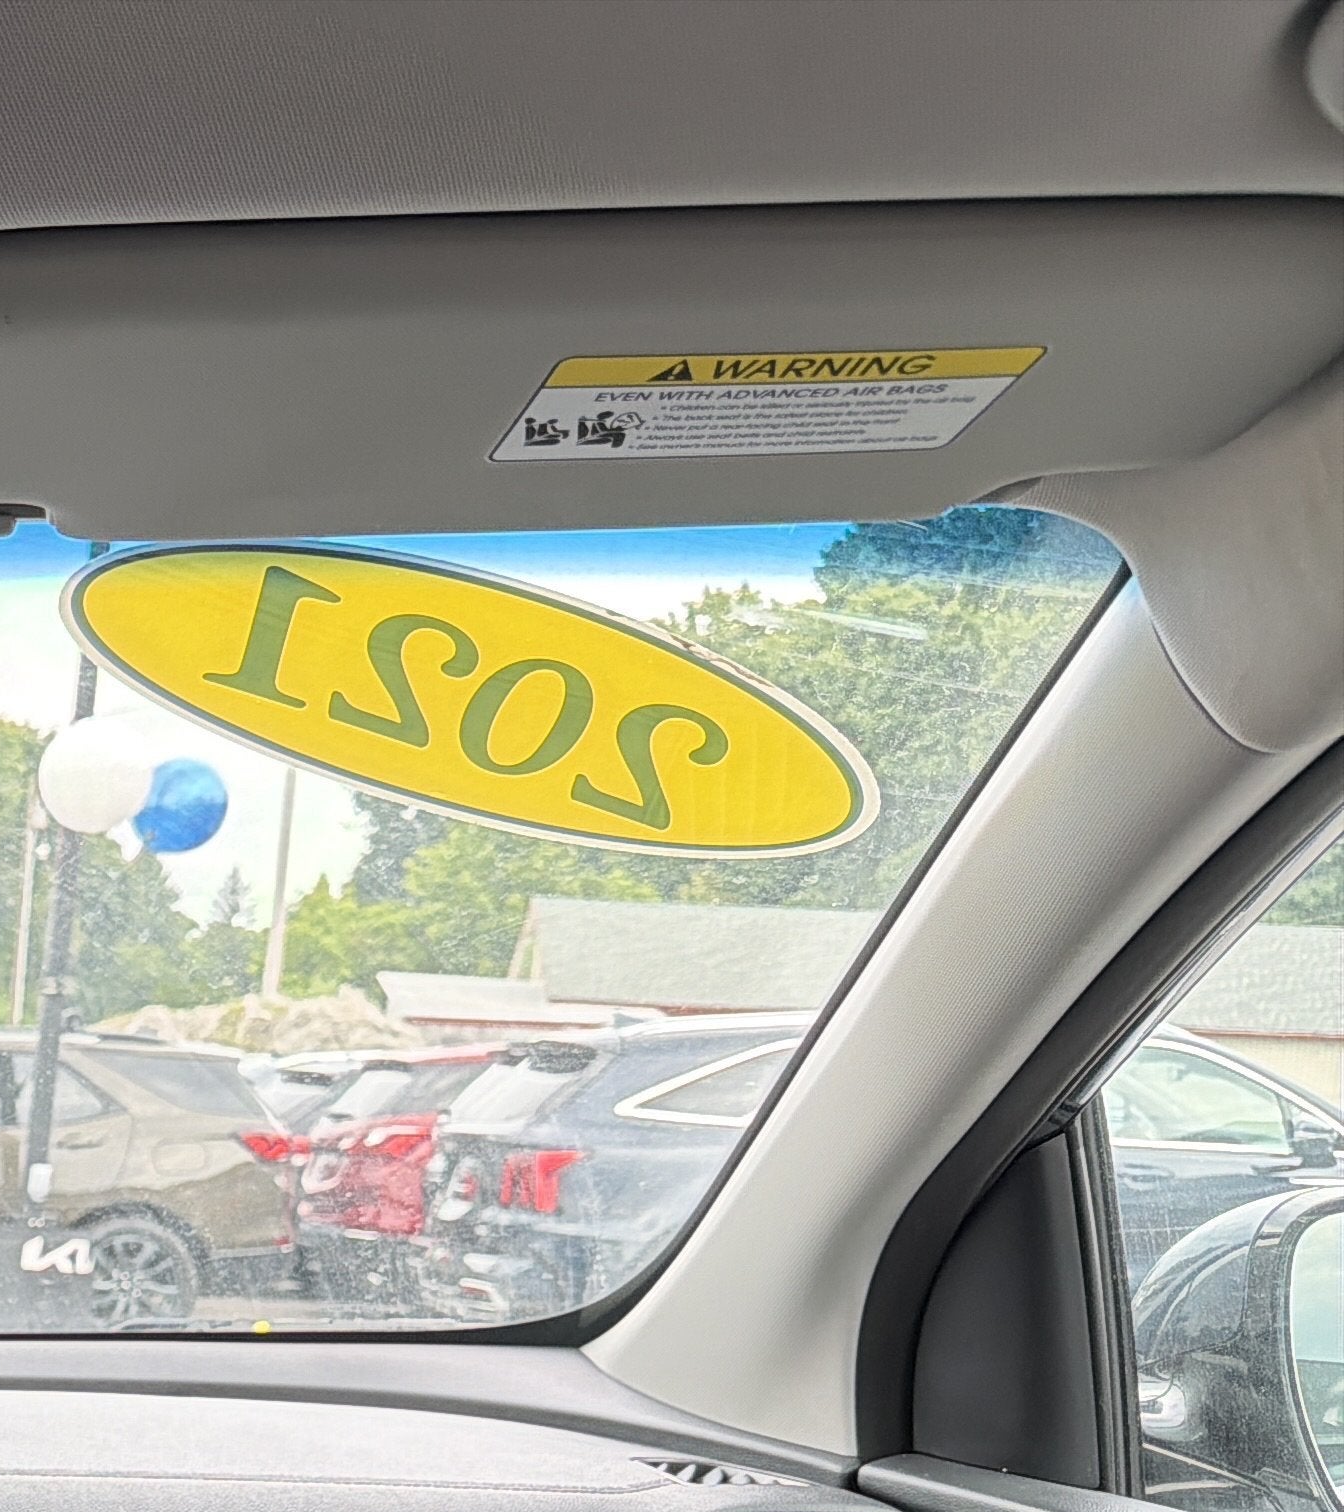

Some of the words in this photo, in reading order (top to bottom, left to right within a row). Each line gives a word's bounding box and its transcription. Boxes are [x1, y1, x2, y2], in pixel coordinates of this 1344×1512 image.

[713, 355, 936, 379] WARNING
[594, 391, 653, 402] EVEN
[659, 390, 714, 401] WITH
[717, 388, 839, 400] ADVANCED
[843, 386, 882, 397] AIR
[887, 384, 949, 395] BAGS
